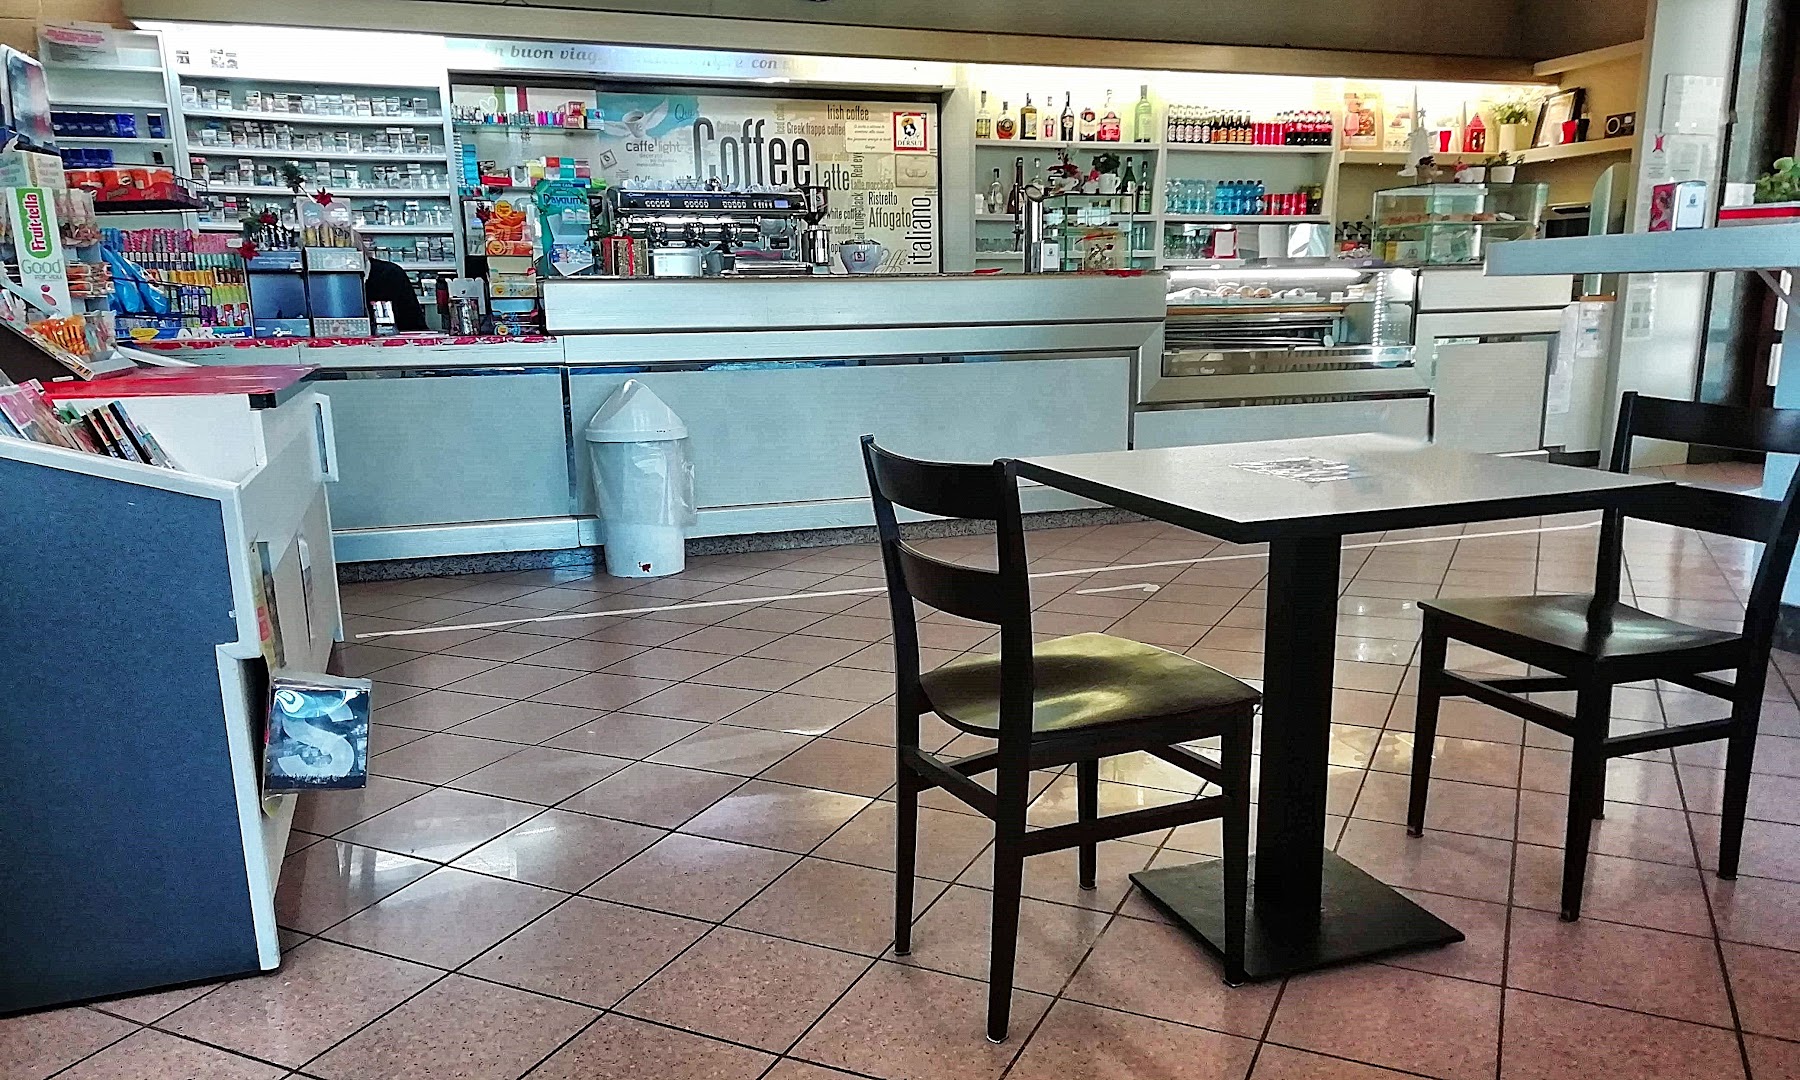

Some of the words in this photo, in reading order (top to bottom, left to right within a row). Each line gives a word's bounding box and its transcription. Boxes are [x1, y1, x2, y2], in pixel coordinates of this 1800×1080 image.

[510, 46, 554, 59] buon
[751, 59, 777, 69] con
[827, 104, 844, 120] Irish
[846, 105, 869, 120] coffee
[786, 121, 805, 135] Greek
[658, 140, 682, 154] light
[693, 117, 810, 190] Coffee
[815, 163, 850, 191] Latte
[850, 164, 863, 178] Red
[868, 191, 898, 206] Ristretto
[868, 207, 912, 231] Affogato
[906, 197, 932, 265] italiano
[21, 258, 61, 275] Good
